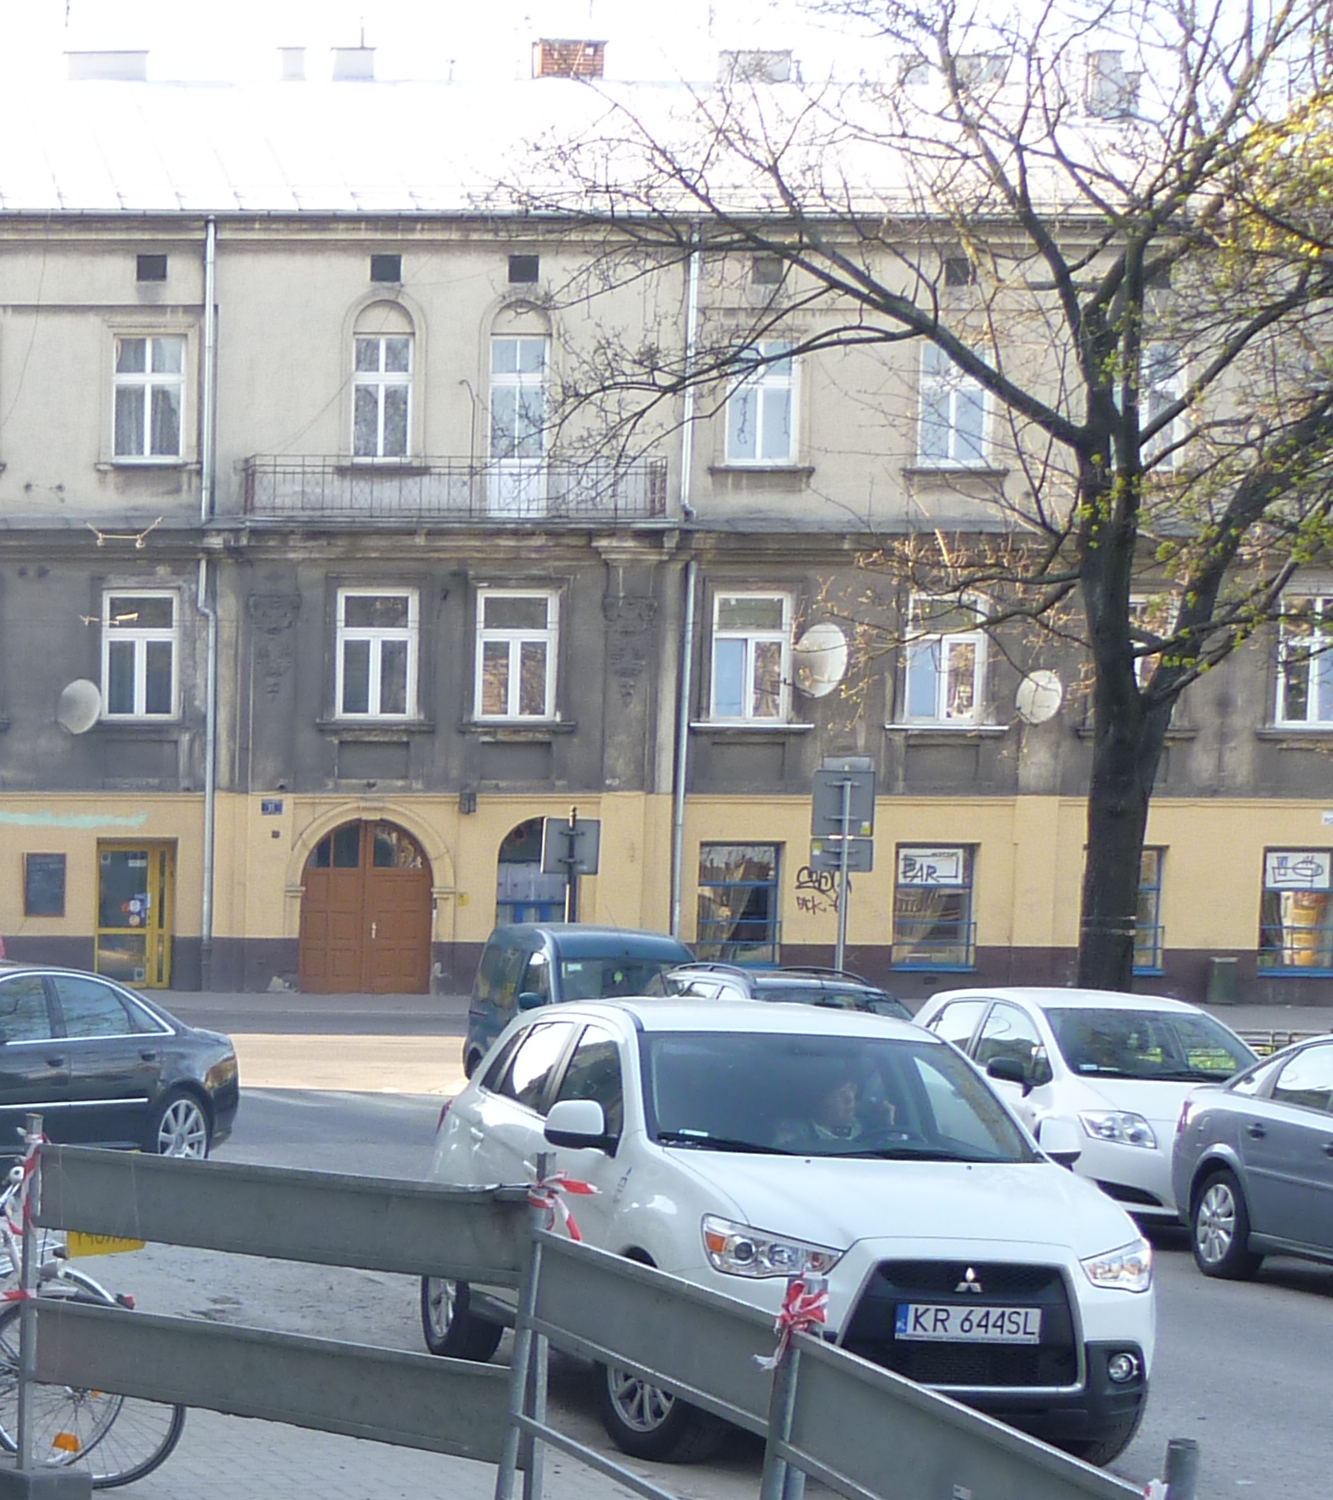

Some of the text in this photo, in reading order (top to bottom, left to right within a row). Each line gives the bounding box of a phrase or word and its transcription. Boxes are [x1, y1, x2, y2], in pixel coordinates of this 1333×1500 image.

[901, 857, 940, 883] BAR
[912, 1307, 1037, 1336] KR 644SL
